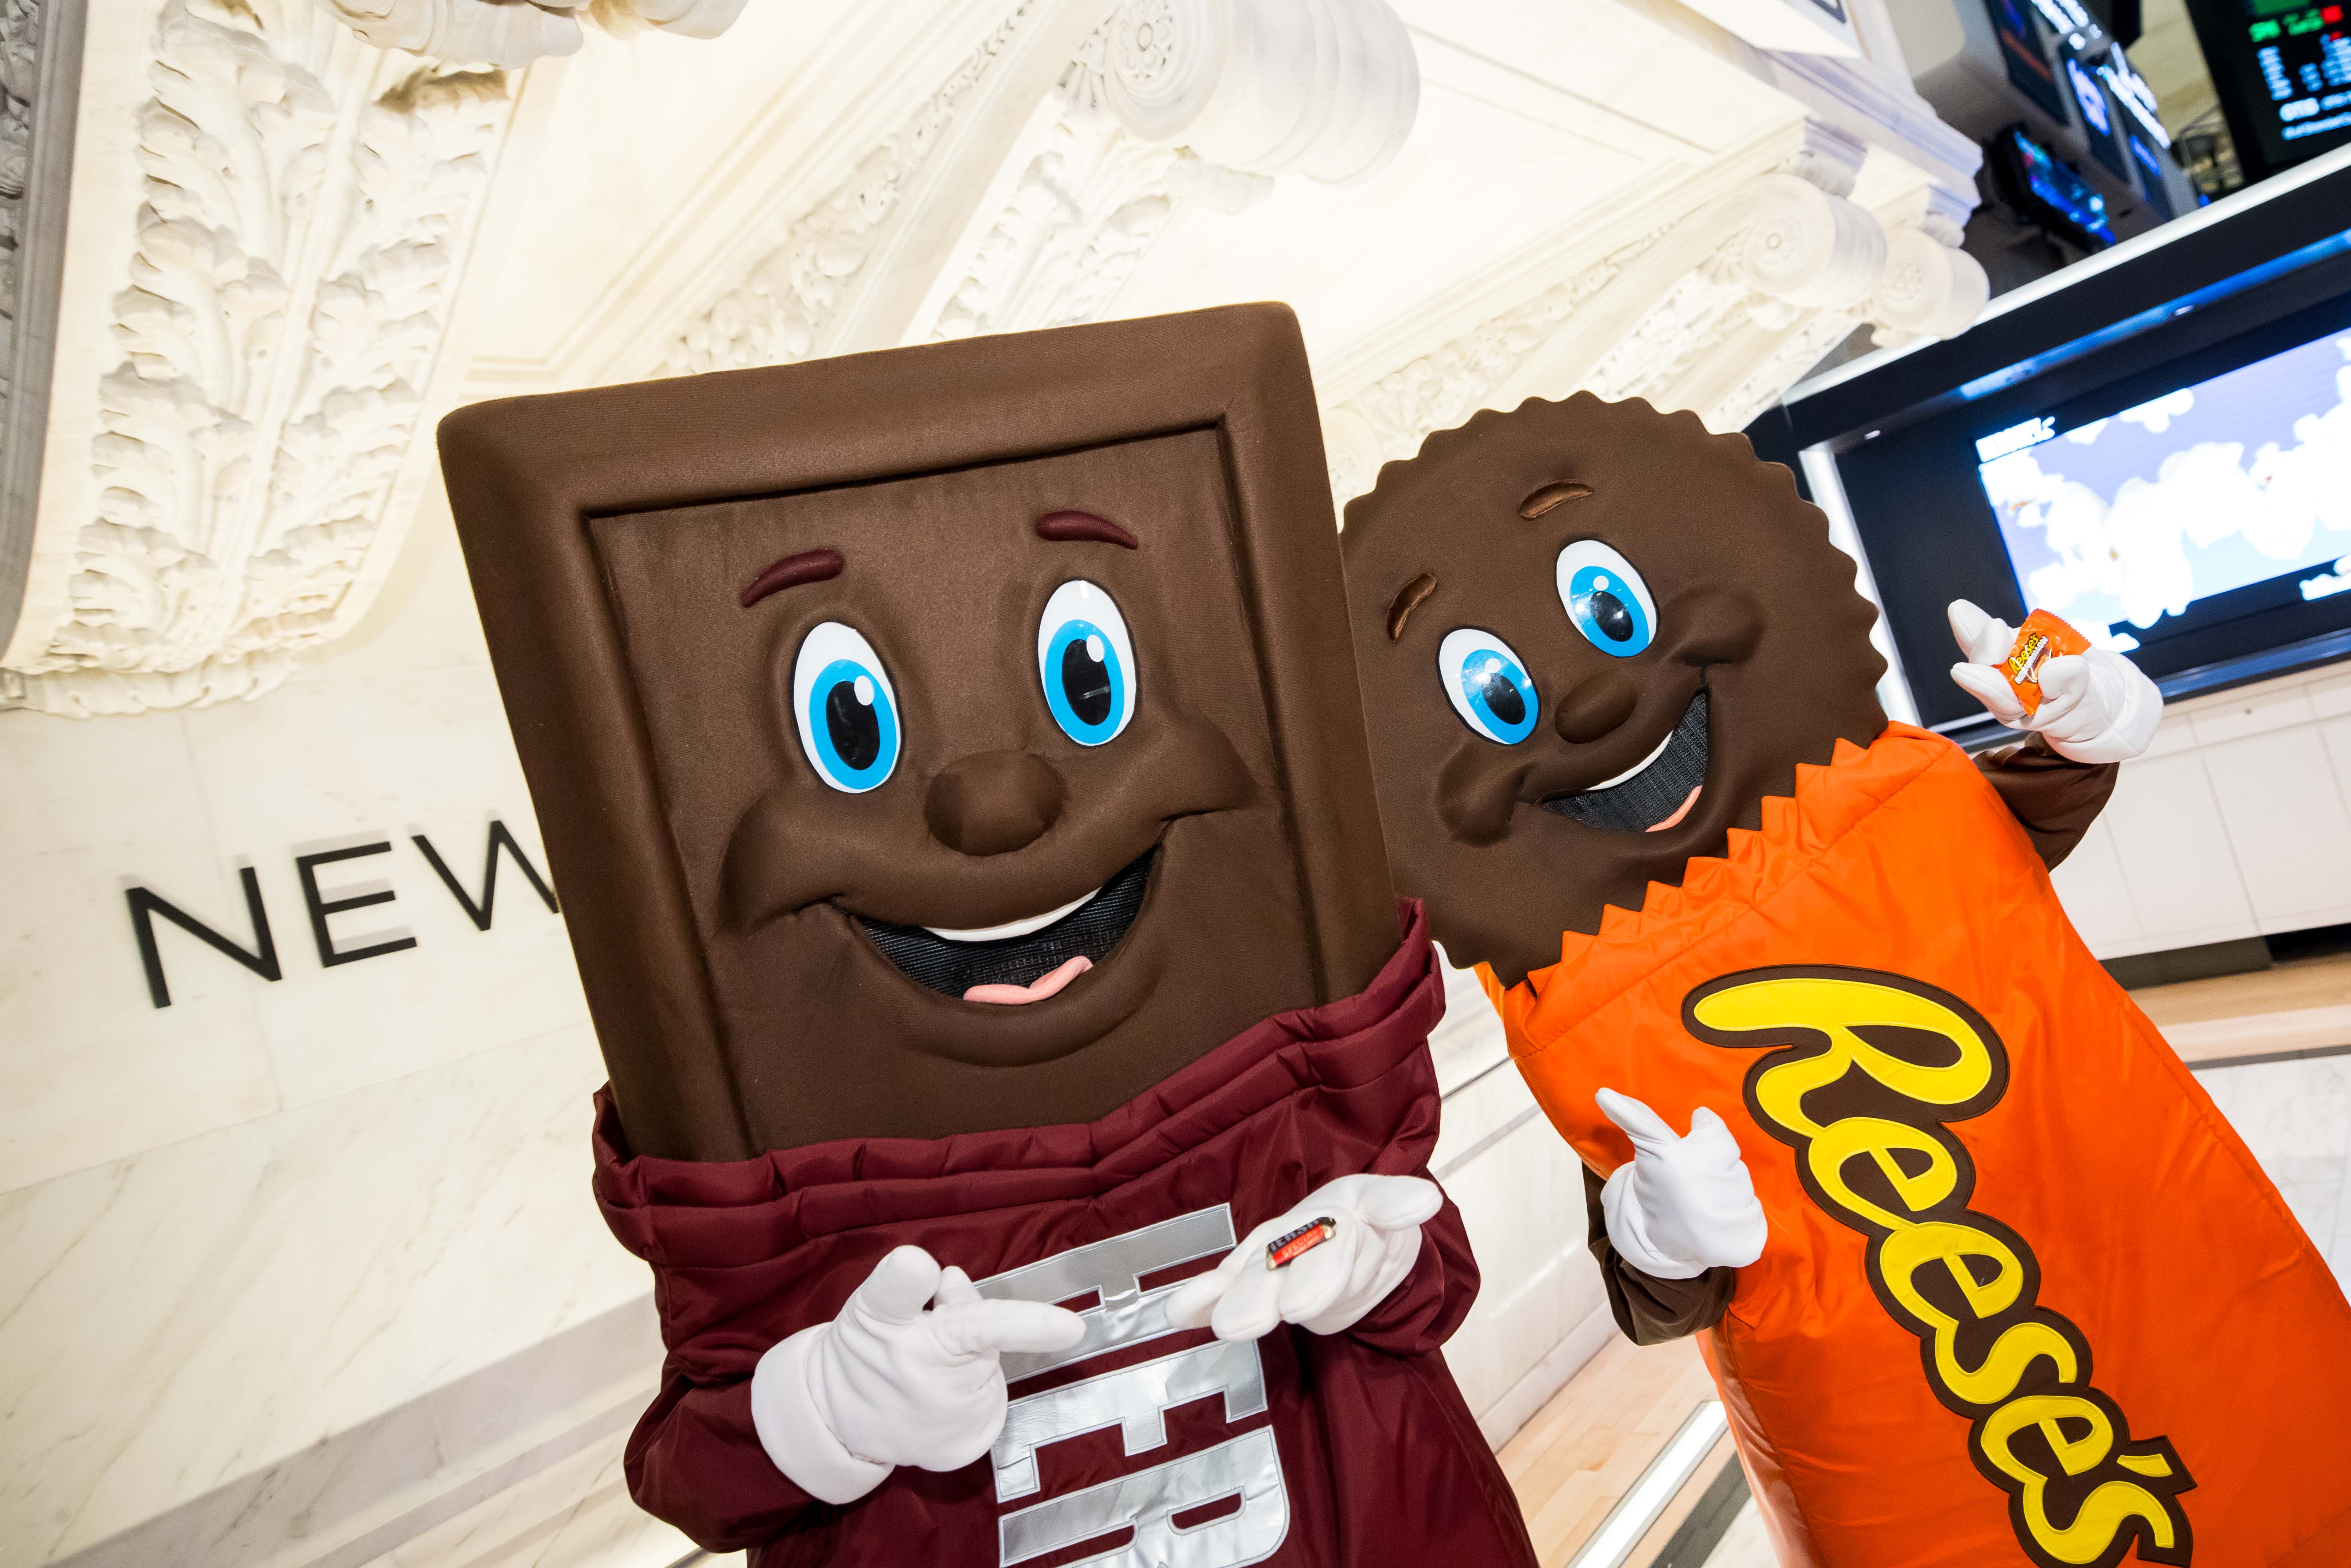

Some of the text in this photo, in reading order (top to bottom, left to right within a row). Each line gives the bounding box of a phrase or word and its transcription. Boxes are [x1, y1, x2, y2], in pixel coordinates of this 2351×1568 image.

[2008, 633, 2039, 675] Reese's
[124, 820, 561, 1009] NEW
[1688, 973, 2181, 1567] Reese's
